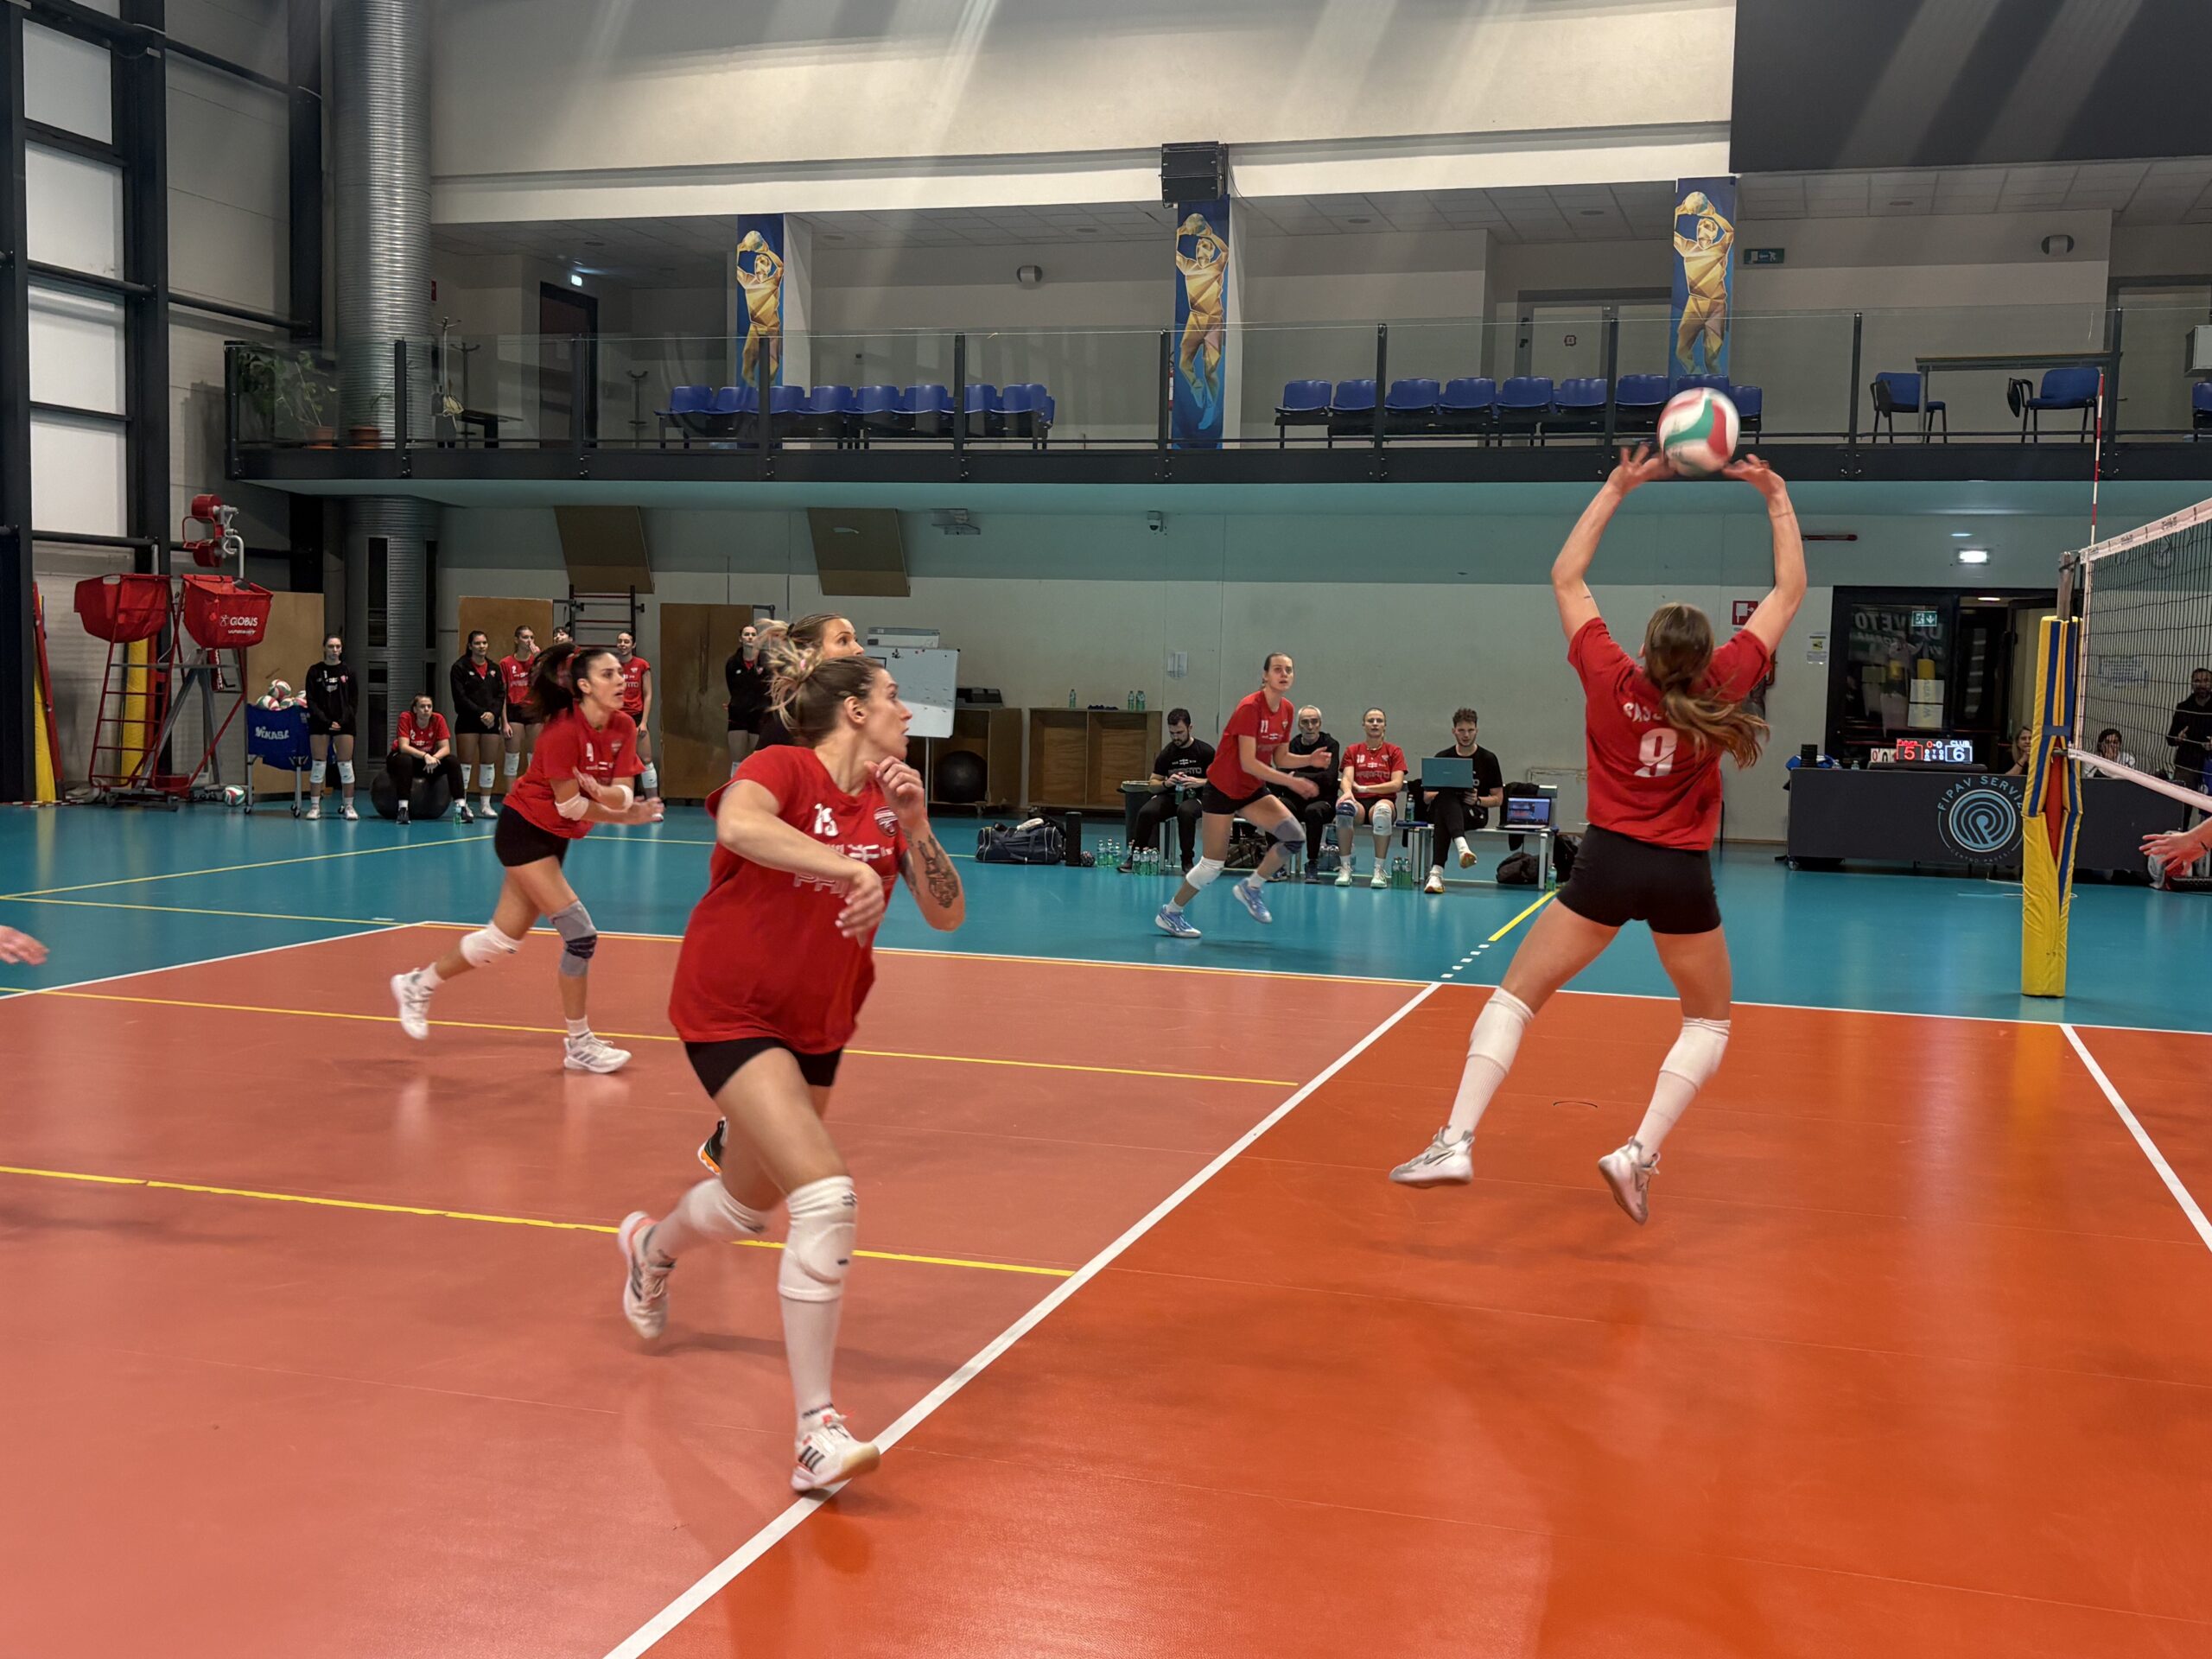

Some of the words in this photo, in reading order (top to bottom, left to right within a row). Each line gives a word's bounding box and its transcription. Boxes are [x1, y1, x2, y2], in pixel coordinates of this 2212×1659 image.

[1261, 720, 1268, 733] 11
[1633, 728, 1678, 778] 9
[1904, 747, 1916, 760] 5
[1953, 747, 1966, 761] 6
[1937, 777, 1971, 811] FIPAV
